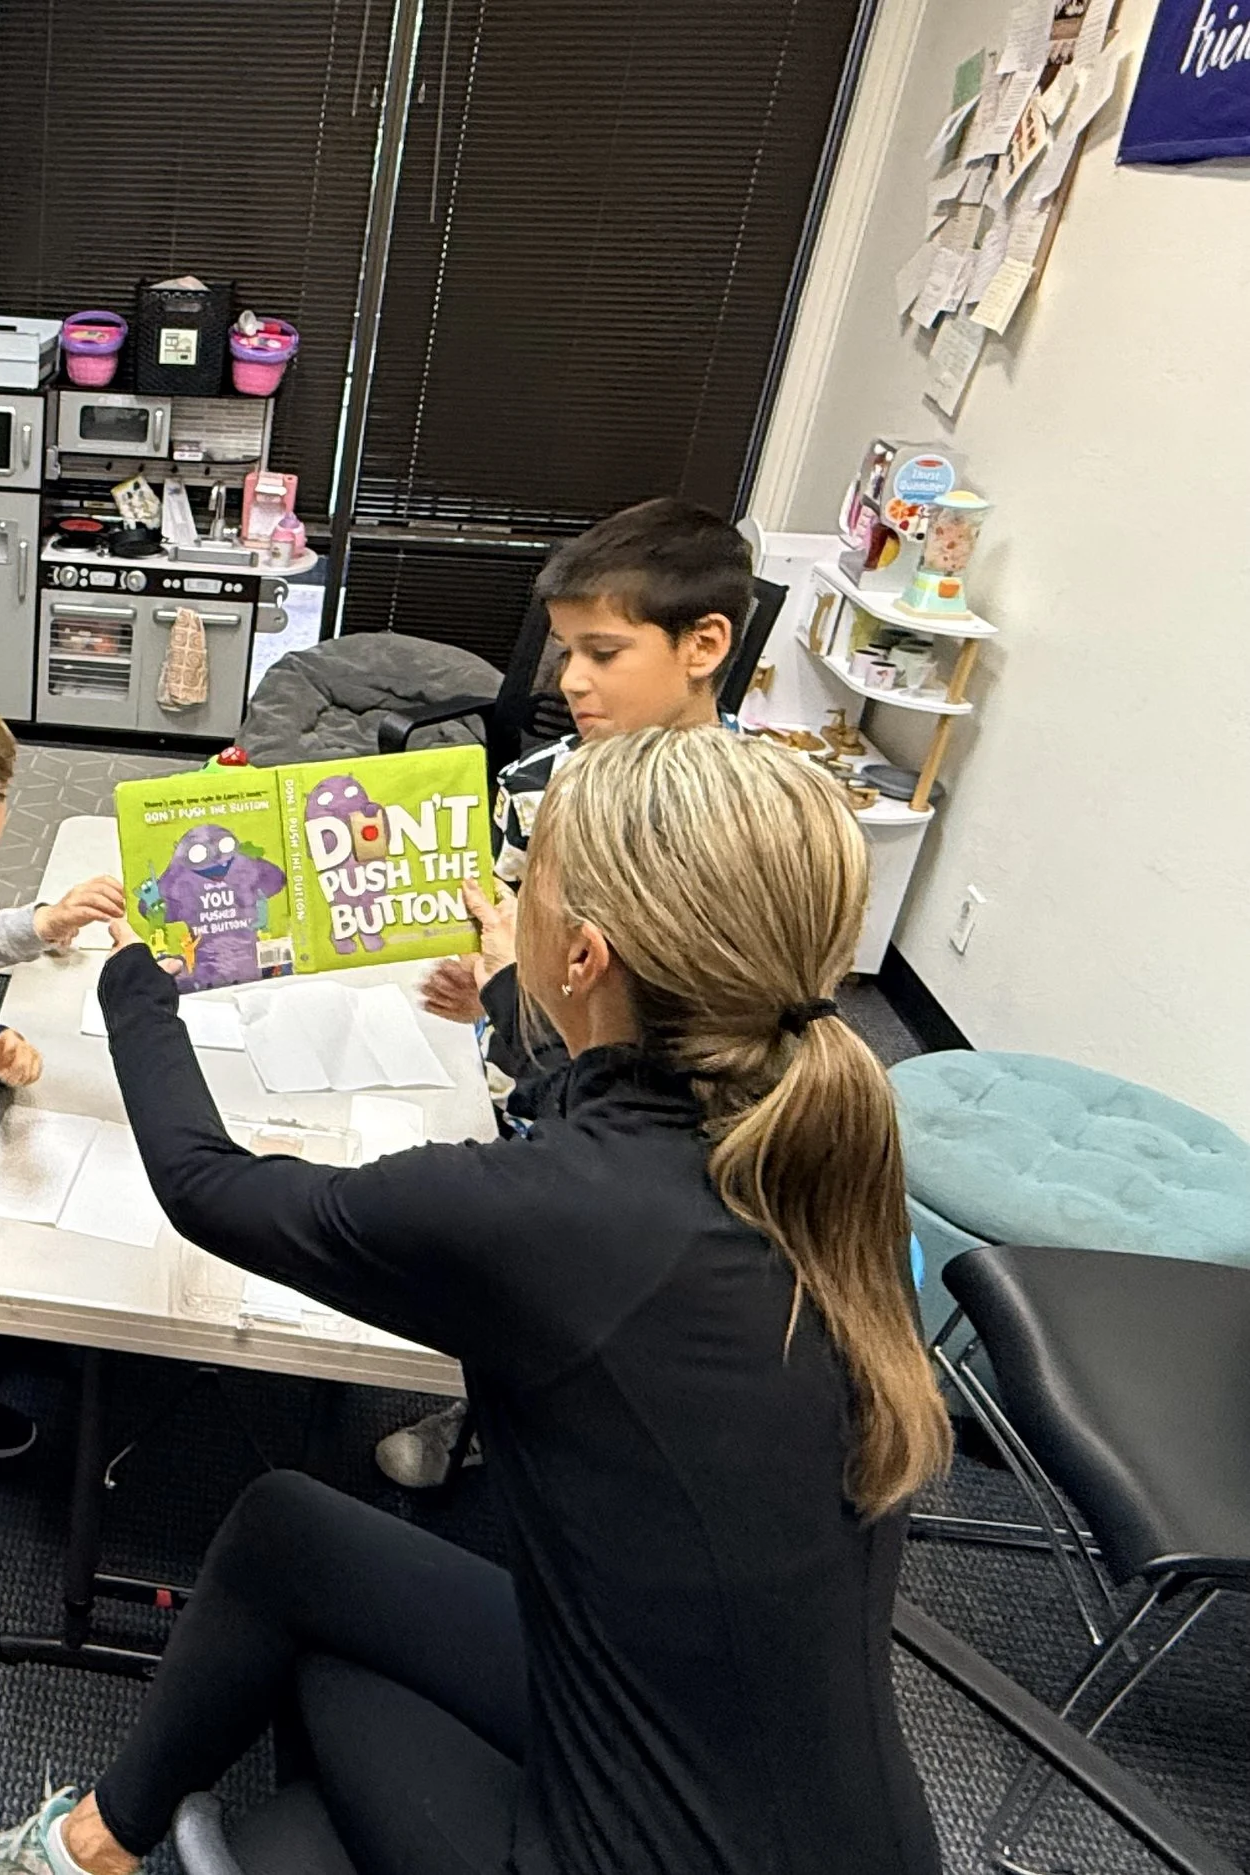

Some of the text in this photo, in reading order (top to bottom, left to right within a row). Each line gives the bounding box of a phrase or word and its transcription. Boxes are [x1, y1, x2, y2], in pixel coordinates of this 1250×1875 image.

[144, 800, 270, 824] DON'T PUSH THE BUTTON
[288, 817, 299, 849] PUSH
[290, 852, 302, 872] THE
[317, 850, 480, 904] PUSH THE
[199, 890, 235, 909] YOU
[199, 908, 237, 923] PUSHED
[330, 887, 469, 941] BUTTON
[192, 924, 210, 937] THE
